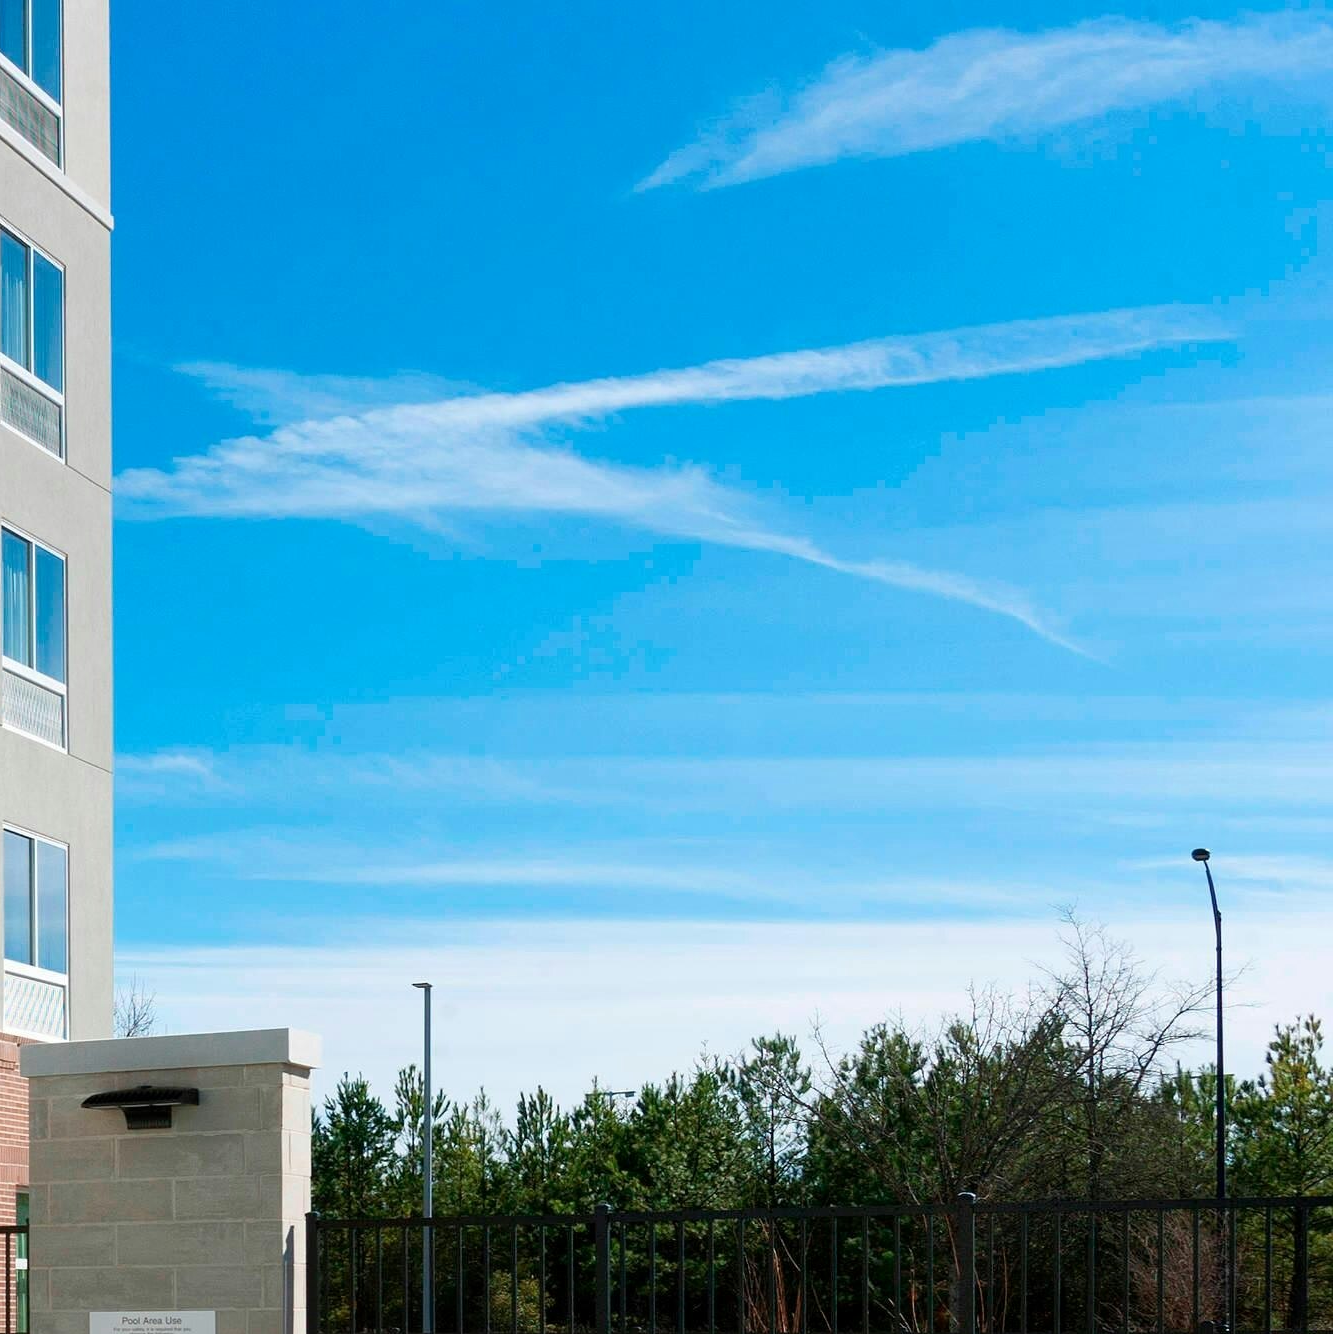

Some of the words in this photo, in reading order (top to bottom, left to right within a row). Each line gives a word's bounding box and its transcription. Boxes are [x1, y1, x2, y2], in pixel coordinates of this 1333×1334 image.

[121, 1316, 140, 1325] Pool
[143, 1316, 162, 1325] Area
[165, 1316, 182, 1325] Use
